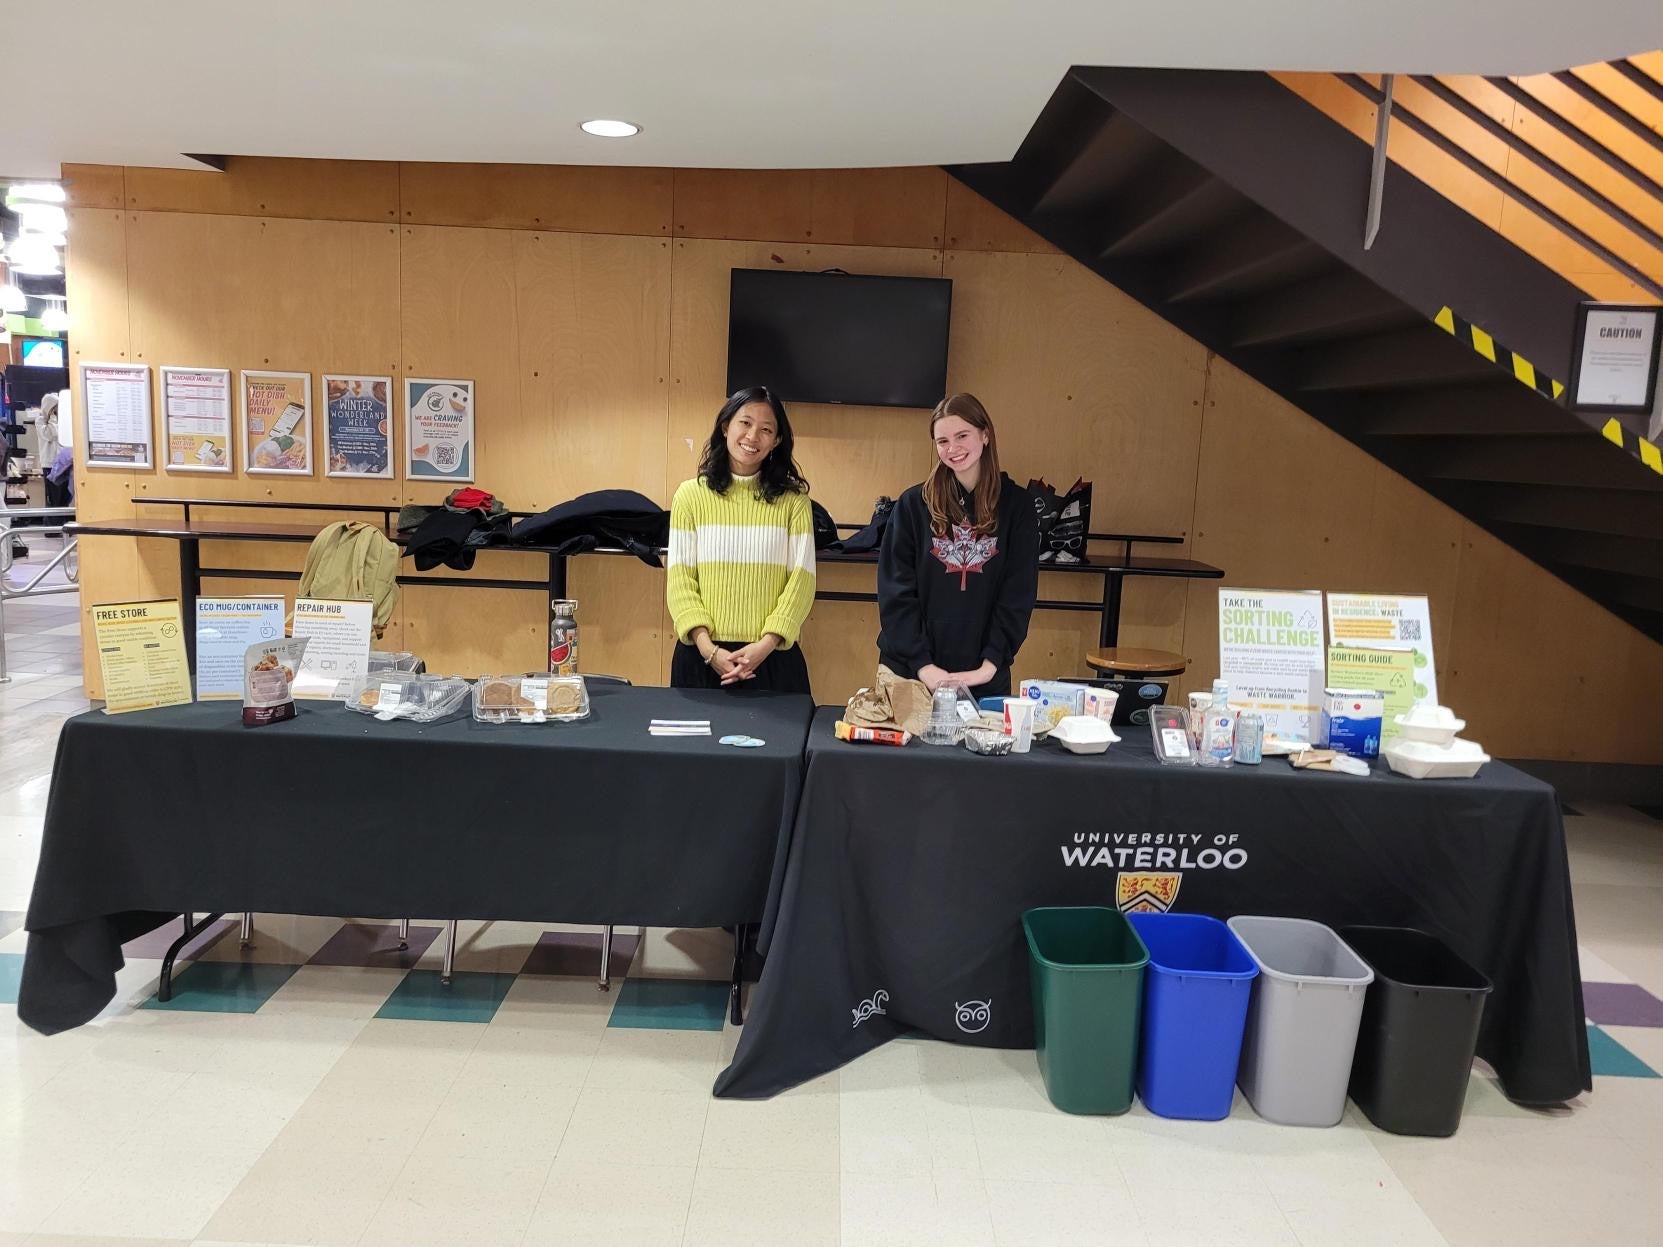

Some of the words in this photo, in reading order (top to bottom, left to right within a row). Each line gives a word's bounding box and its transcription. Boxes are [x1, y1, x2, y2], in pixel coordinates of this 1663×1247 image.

[1600, 327, 1642, 339] CAUTION
[267, 391, 286, 400] DISH
[340, 400, 373, 411] WINTER
[249, 407, 276, 416] MENU!
[332, 410, 384, 420] WONDERLAND
[434, 414, 463, 422] CRAVING
[216, 603, 279, 611] MUG/CONTAINER
[297, 604, 324, 613] REPAIR
[1224, 598, 1245, 608] TAKE
[1247, 599, 1264, 608] THE
[96, 610, 118, 620] FREE
[120, 608, 148, 619] STORE
[1223, 608, 1294, 627] SORTING
[1223, 627, 1319, 647] CHALLENGE
[1331, 652, 1366, 663] SORTING
[1368, 654, 1393, 664] GUIDE
[1074, 832, 1202, 845] UNIVERSITY
[1214, 834, 1239, 845] OF
[1060, 846, 1248, 869] WATERLOO
